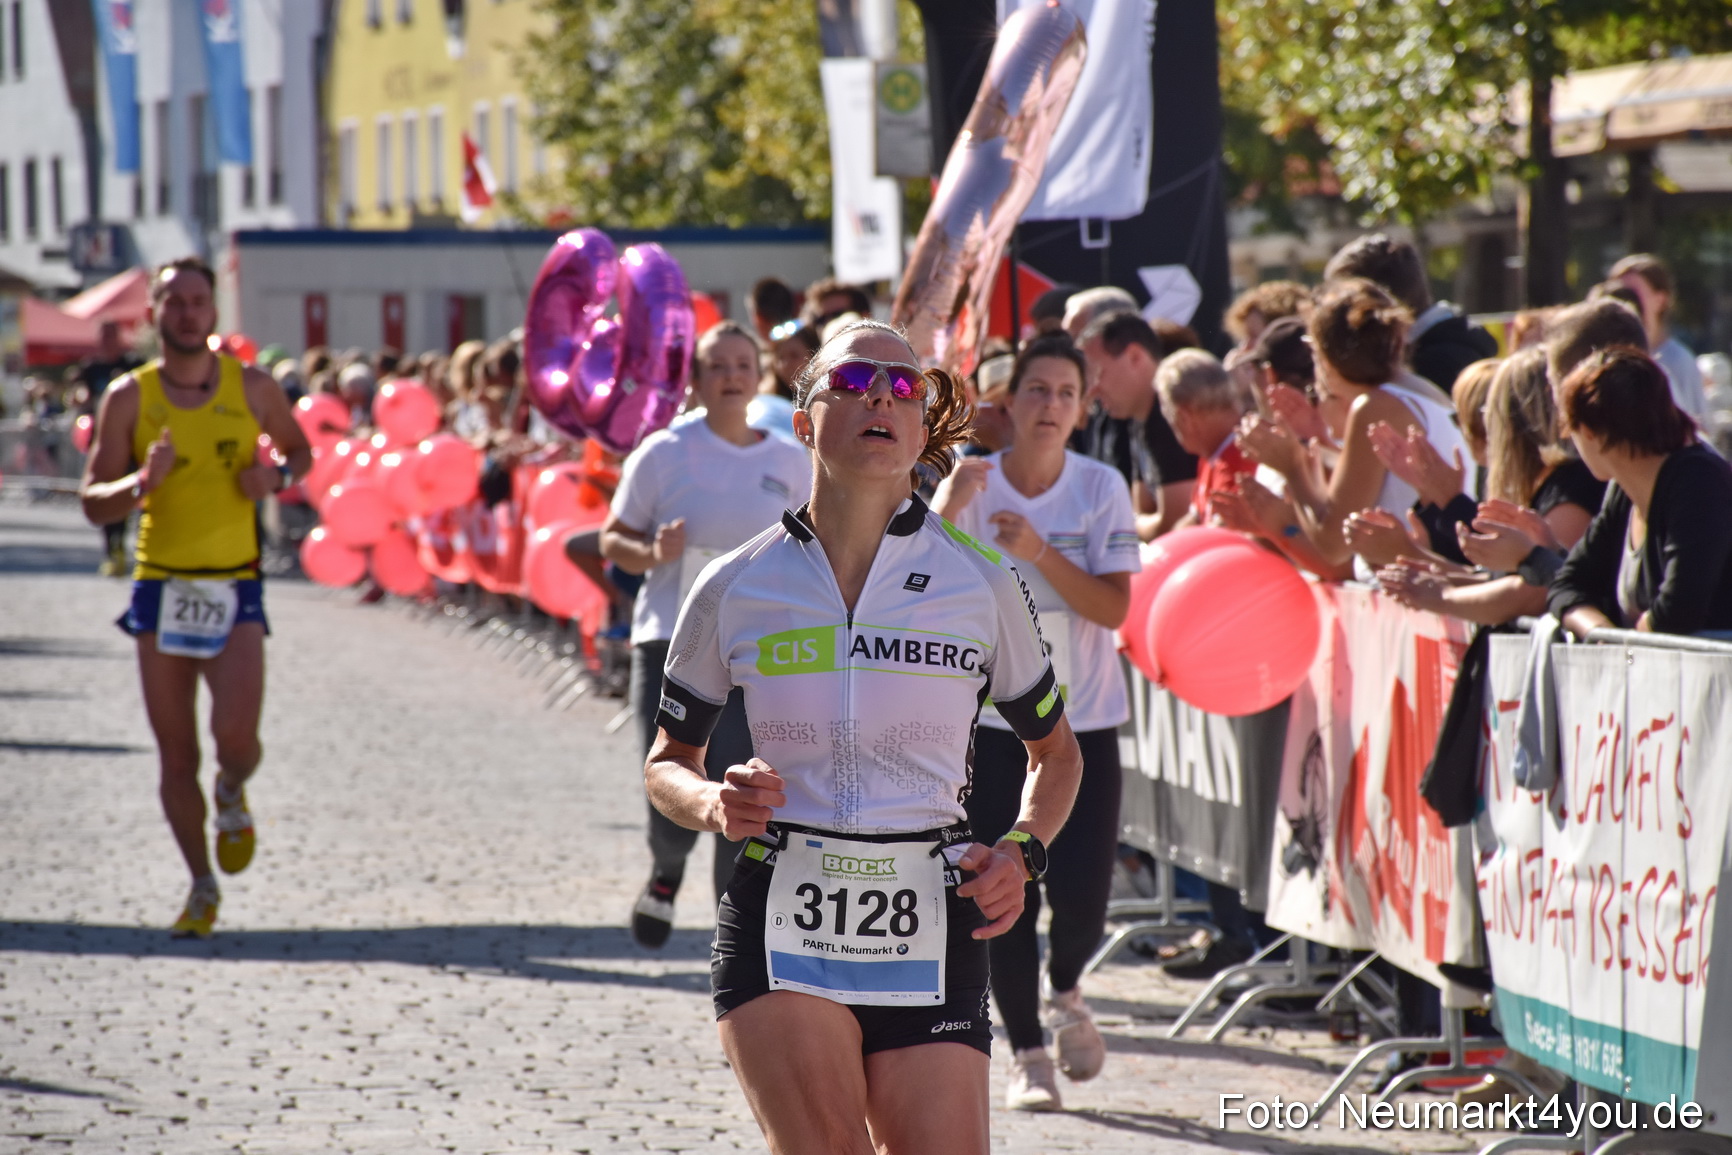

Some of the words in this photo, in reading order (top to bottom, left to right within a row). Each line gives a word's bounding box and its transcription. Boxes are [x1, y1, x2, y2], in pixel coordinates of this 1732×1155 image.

[174, 599, 226, 626] 2179
[772, 638, 819, 665] CIS
[850, 634, 979, 672] AMBERG
[822, 853, 897, 876] BOCK
[822, 871, 844, 880] inspired
[794, 883, 919, 937] 3128
[803, 939, 839, 953] PARTL
[841, 945, 893, 955] Neumarkt
